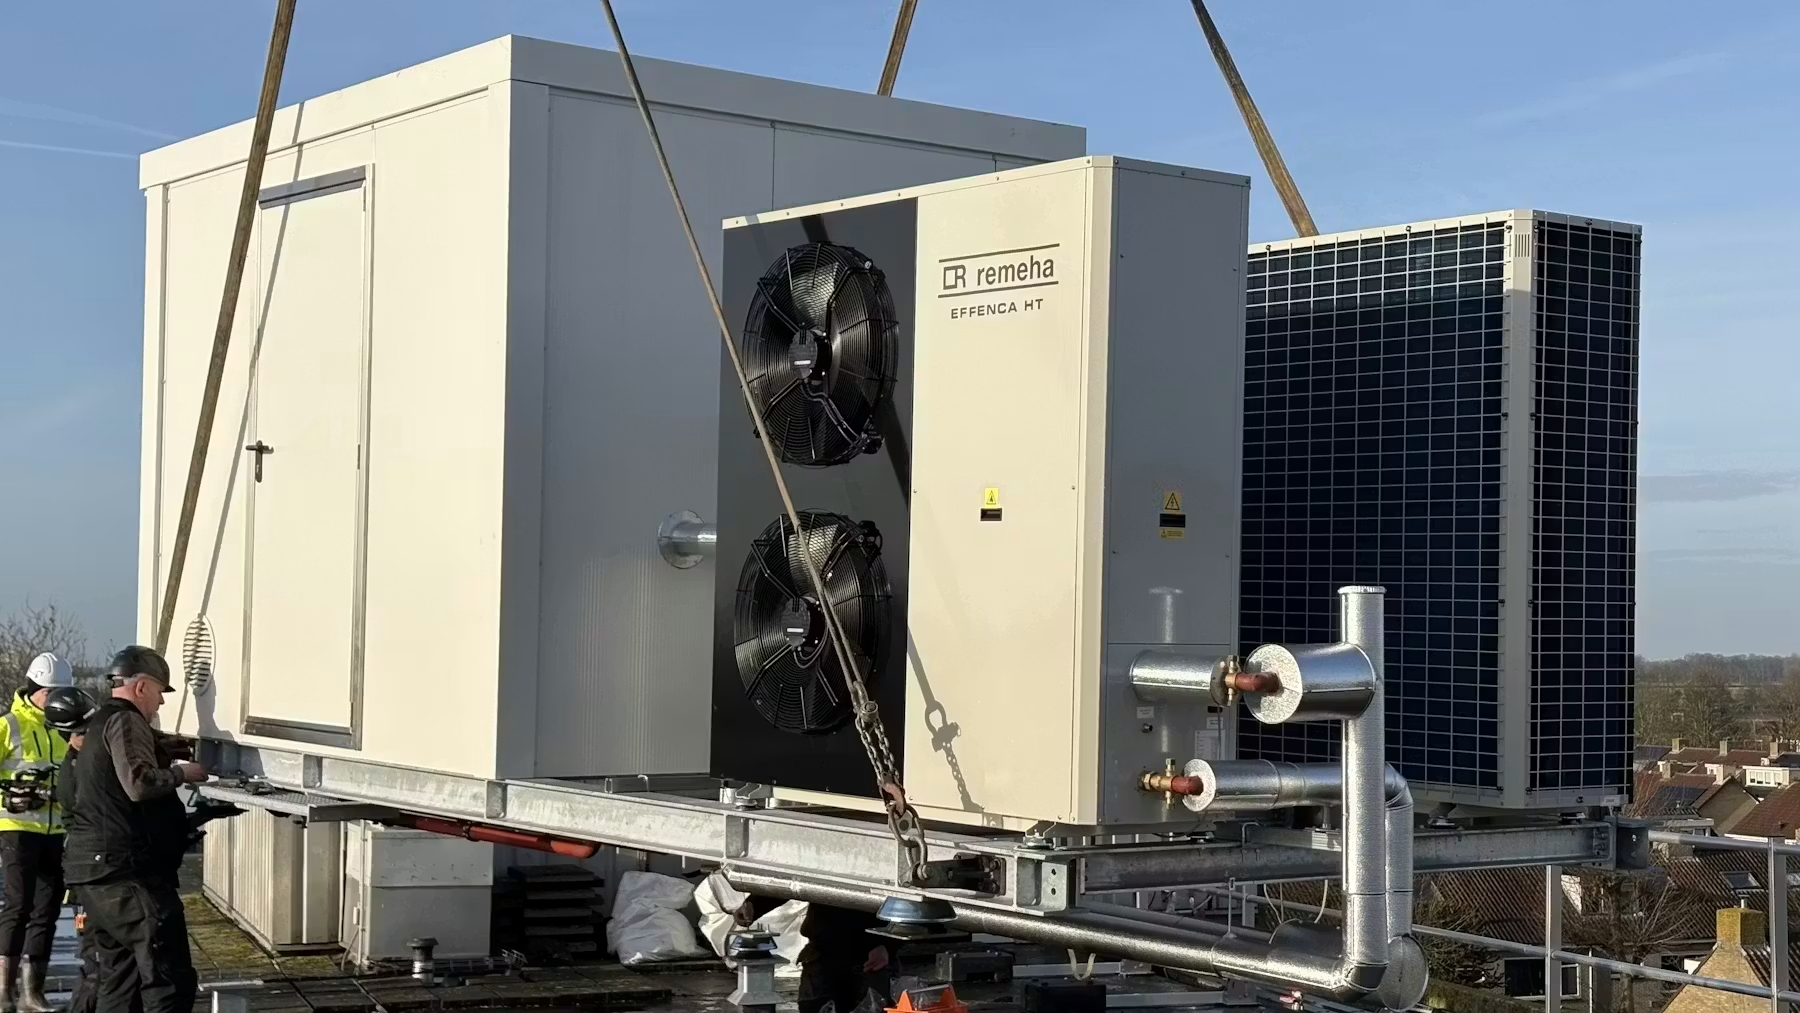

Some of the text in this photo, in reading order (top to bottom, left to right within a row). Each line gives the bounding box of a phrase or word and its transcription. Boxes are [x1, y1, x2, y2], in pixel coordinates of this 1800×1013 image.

[977, 255, 1054, 286] remeha
[951, 298, 1043, 319] EFFENCA HT
